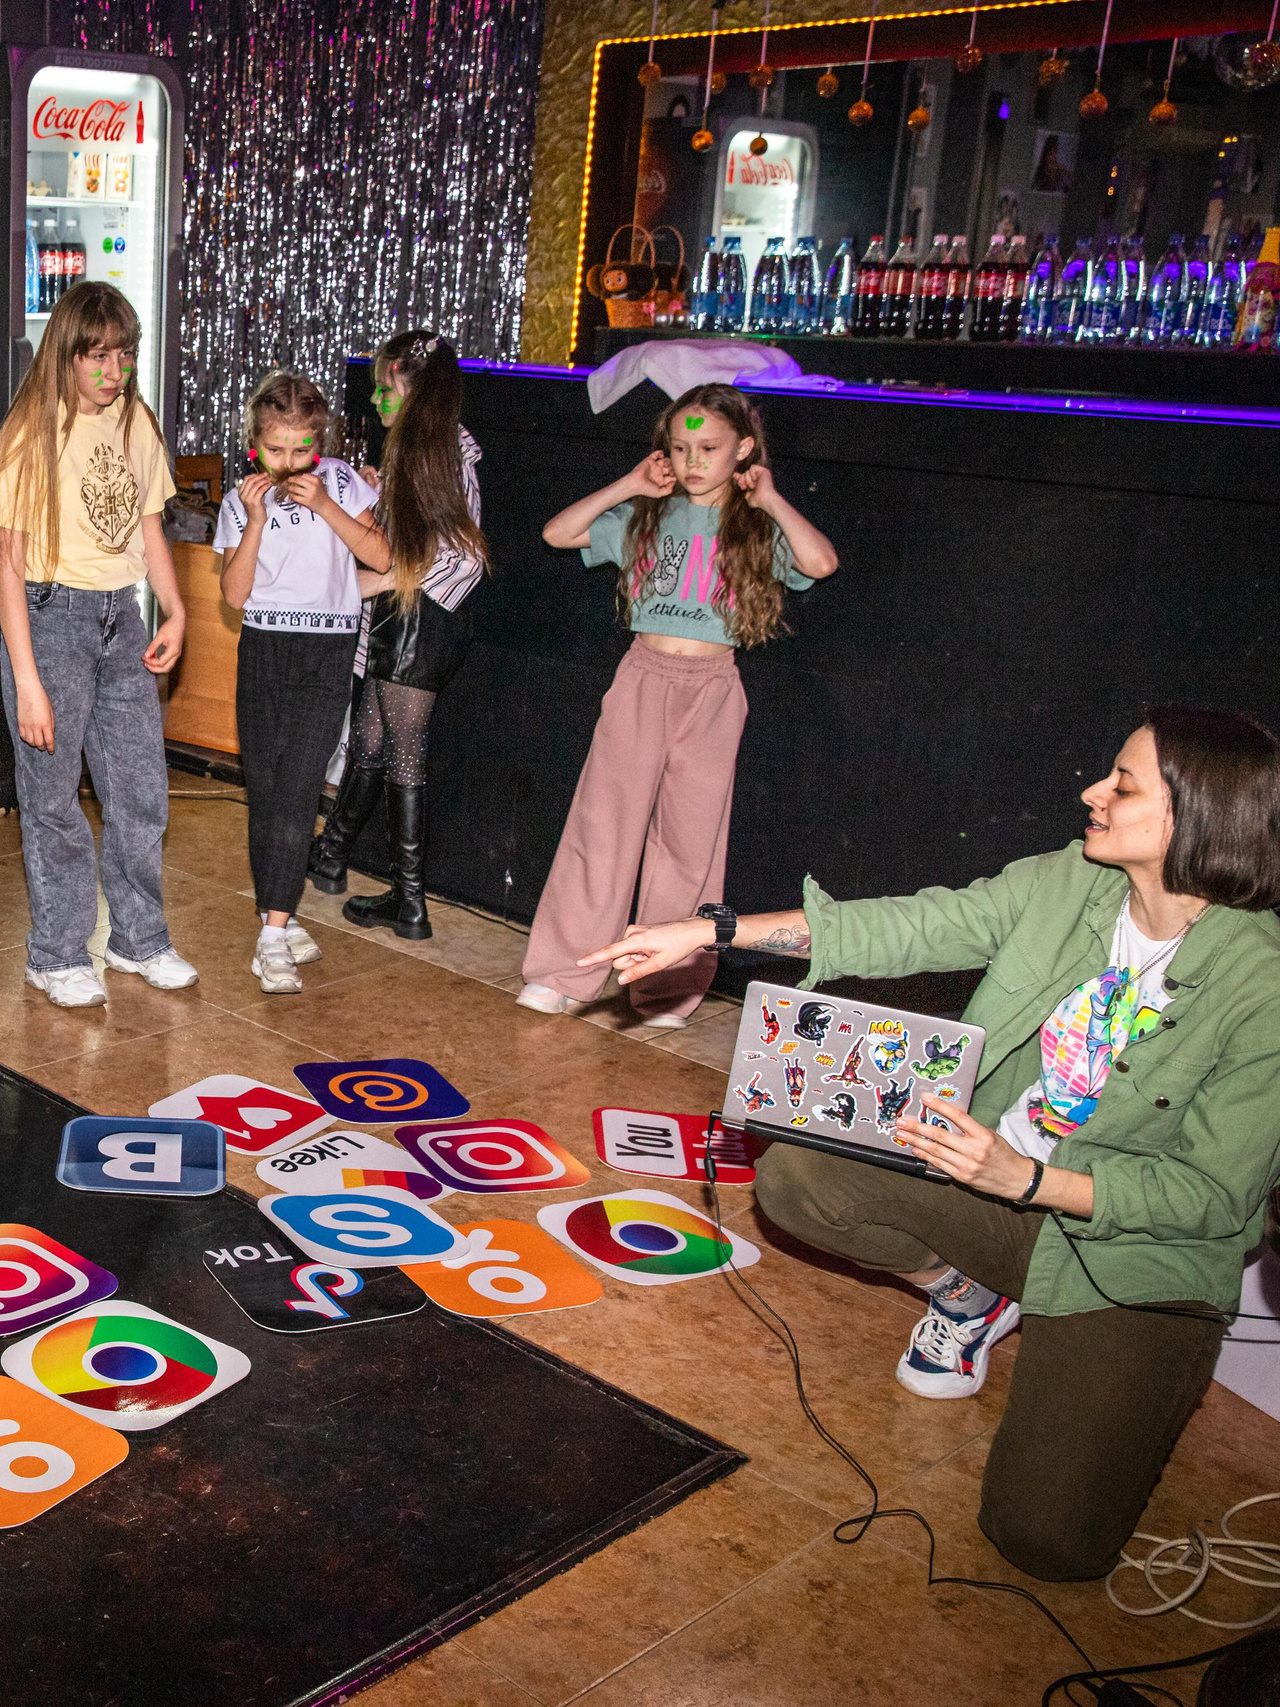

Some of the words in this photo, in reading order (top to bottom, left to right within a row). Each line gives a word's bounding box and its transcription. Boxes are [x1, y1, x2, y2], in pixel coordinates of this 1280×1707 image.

[33, 96, 132, 142] Coca-Cola
[270, 509, 316, 530] AGI
[869, 1020, 903, 1036] POW
[270, 1135, 366, 1173] Likee
[615, 1123, 675, 1159] You
[205, 1242, 294, 1268] Tok
